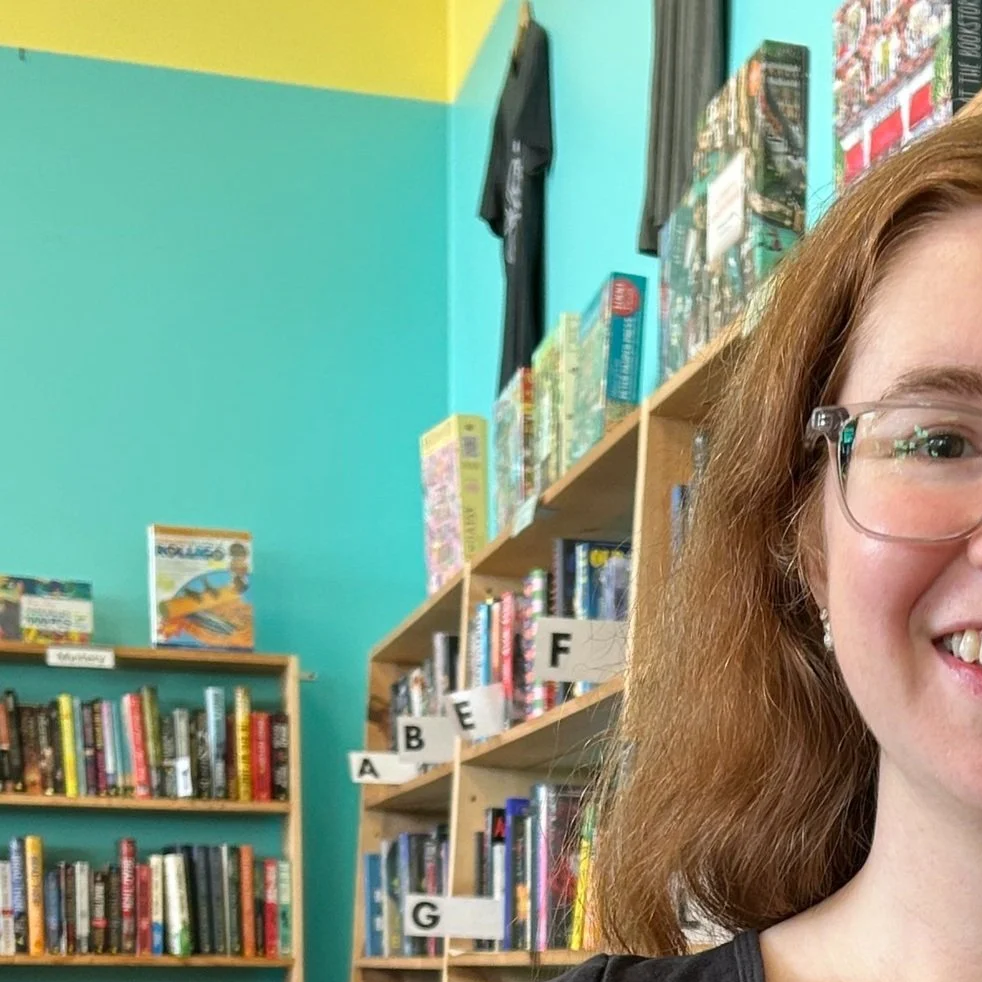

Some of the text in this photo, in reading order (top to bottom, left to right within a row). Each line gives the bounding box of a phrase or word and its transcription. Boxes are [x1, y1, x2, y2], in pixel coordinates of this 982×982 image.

[958, 61, 981, 84] THE
[550, 633, 572, 668] F
[453, 700, 476, 732] E
[404, 725, 425, 751] B
[357, 757, 380, 779] A
[411, 901, 441, 929] G
